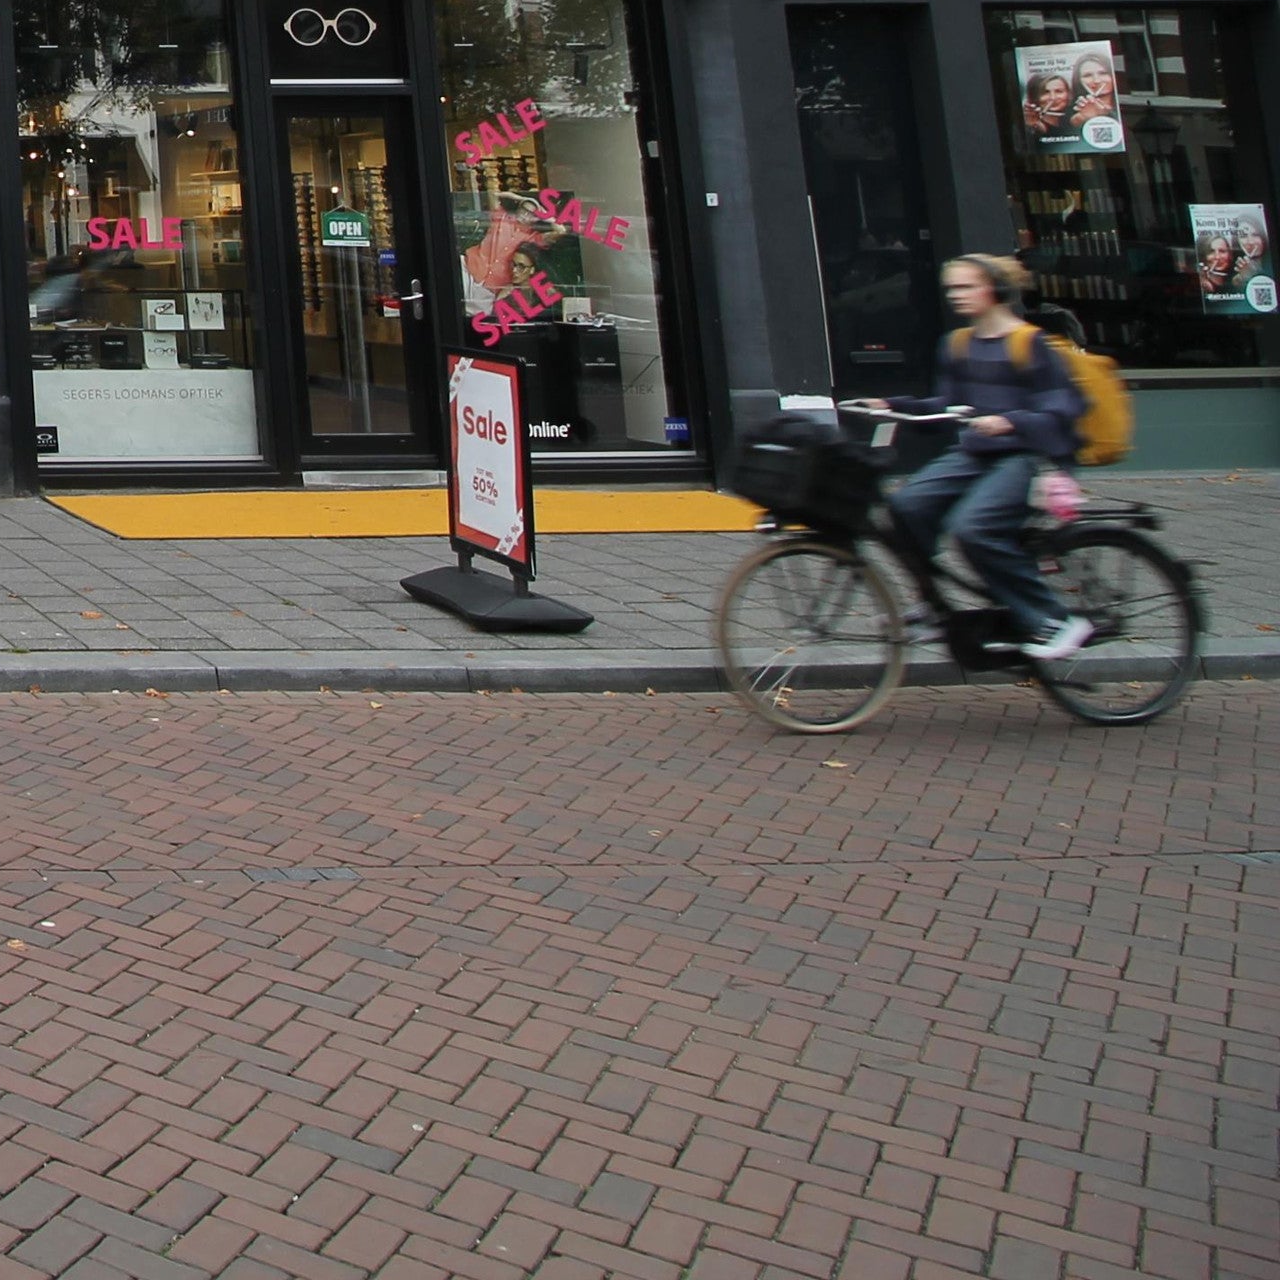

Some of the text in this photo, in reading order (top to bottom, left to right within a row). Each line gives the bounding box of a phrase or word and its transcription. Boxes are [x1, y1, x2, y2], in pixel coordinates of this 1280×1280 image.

[455, 97, 548, 166] SALE
[86, 216, 186, 251] SALE
[329, 221, 362, 236] OPEN
[534, 187, 630, 251] SALE
[471, 271, 563, 347] SALE
[62, 388, 224, 400] SEGERS LOOMANS OPTIEK
[462, 405, 508, 445] Sale
[472, 475, 498, 498] 50%
